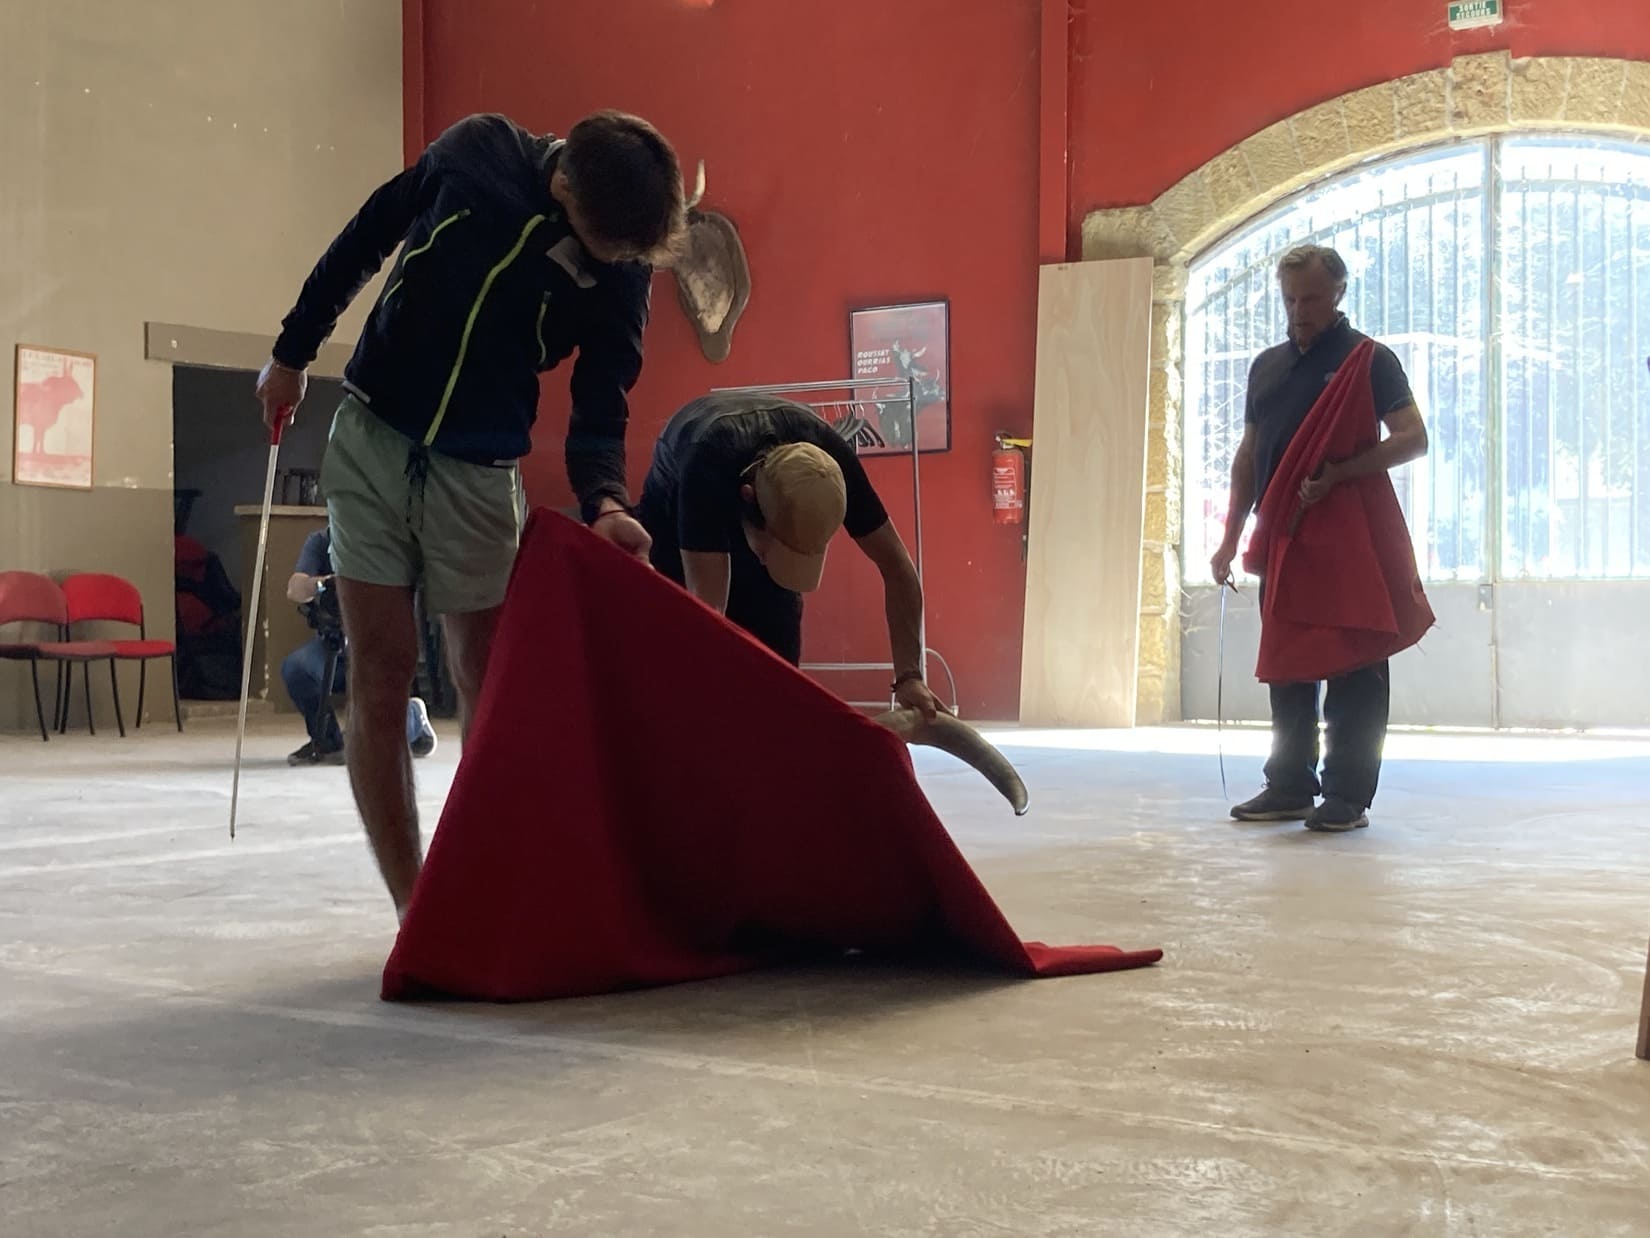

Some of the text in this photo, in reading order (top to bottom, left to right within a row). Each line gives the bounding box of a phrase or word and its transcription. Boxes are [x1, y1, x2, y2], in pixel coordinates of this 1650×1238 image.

[1459, 1, 1486, 12] SORTIE
[1456, 8, 1491, 20] SECOURS
[857, 366, 879, 374] PACO
